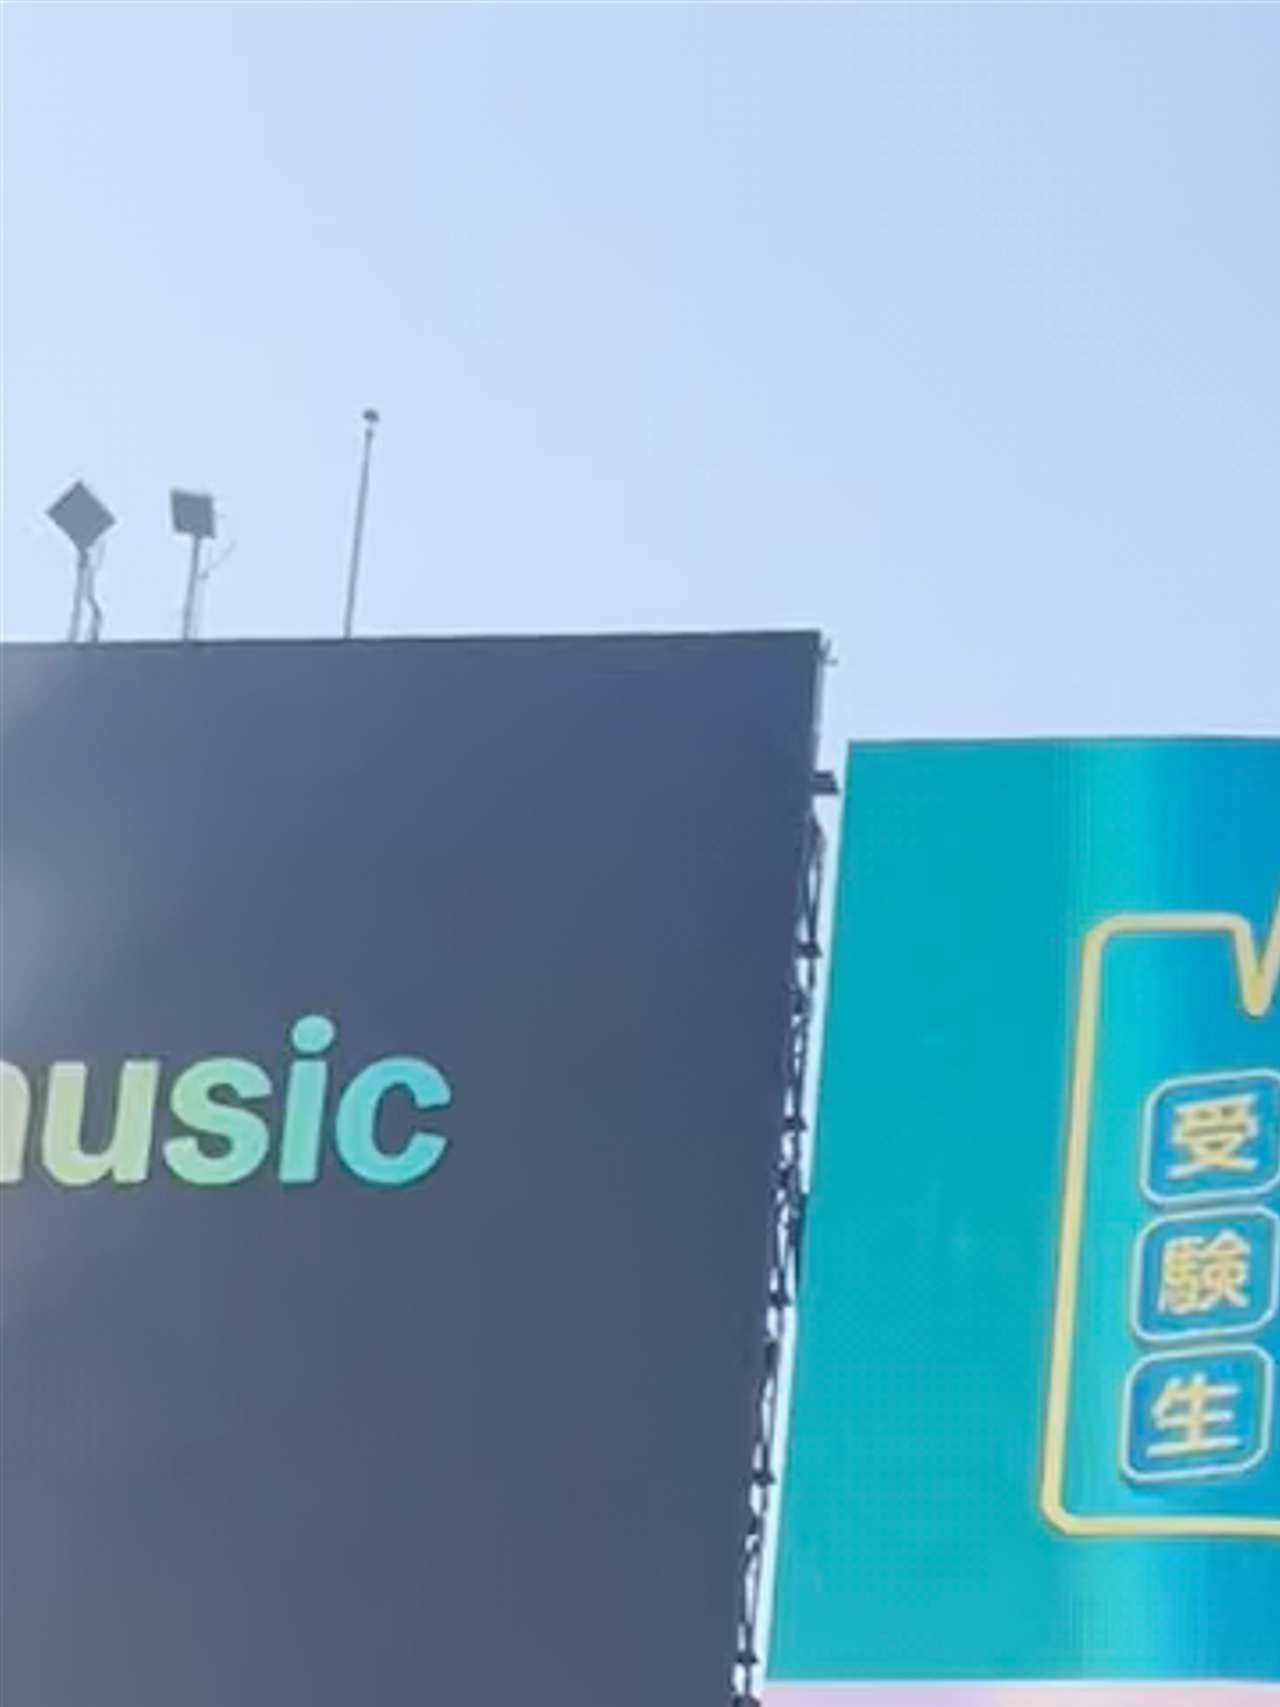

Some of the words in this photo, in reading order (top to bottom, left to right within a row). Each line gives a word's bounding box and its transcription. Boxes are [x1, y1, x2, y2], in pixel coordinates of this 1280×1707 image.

[0, 1015, 452, 1186] usic
[1149, 1096, 1261, 1454] 受験生
